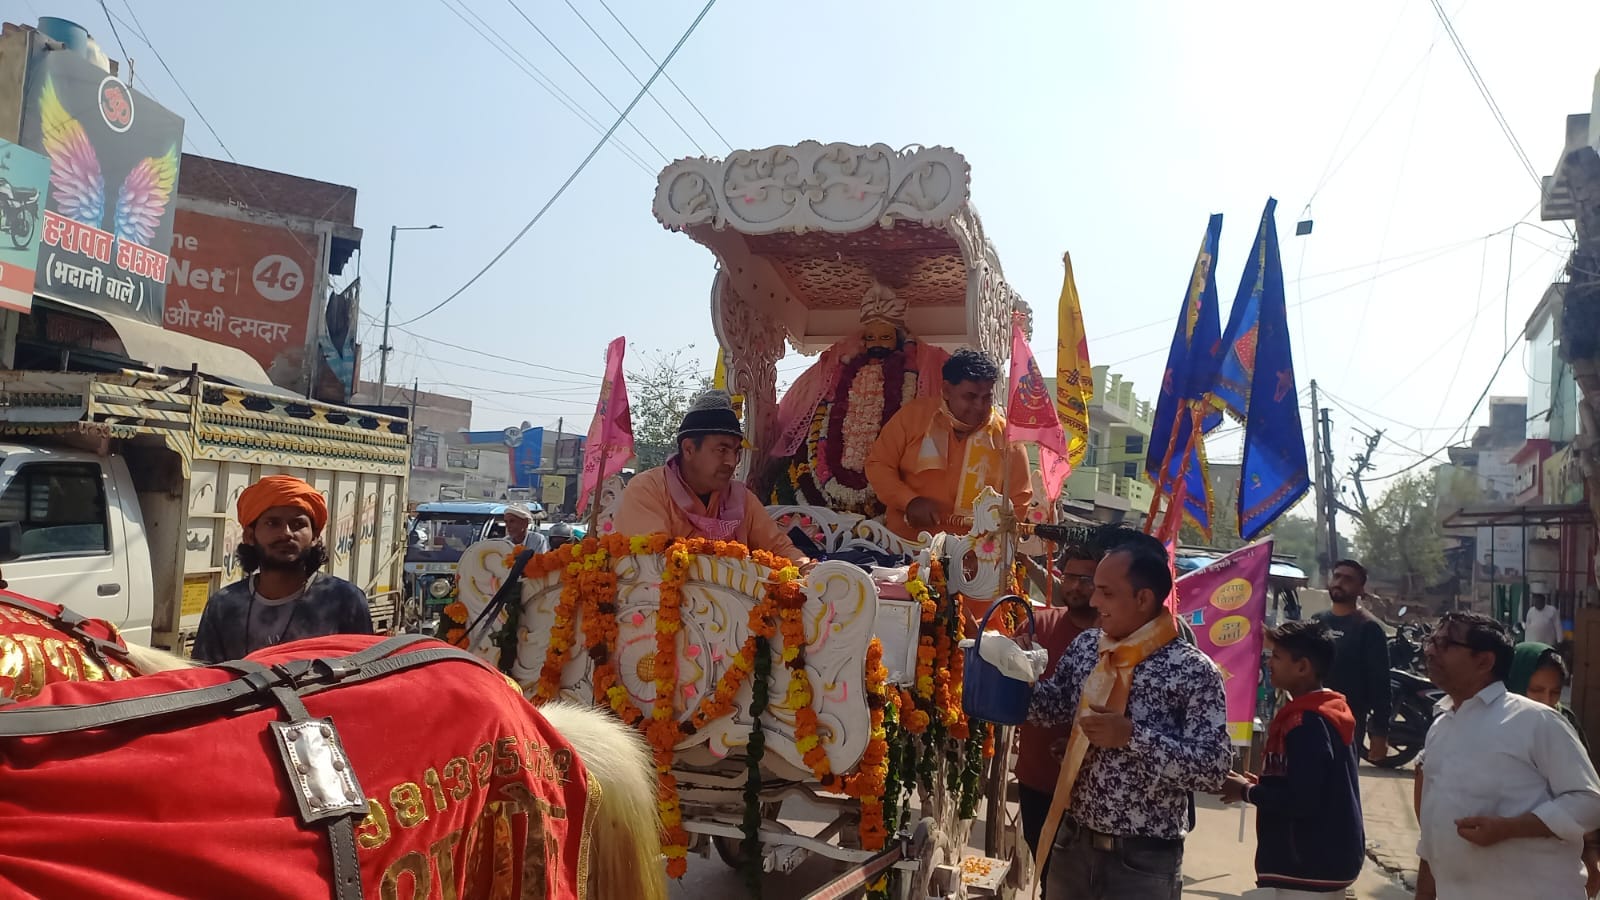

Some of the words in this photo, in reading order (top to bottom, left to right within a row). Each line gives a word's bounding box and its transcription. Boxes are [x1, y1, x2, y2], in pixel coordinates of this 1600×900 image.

[40, 209, 115, 265] हरावत
[117, 237, 169, 284] हाऊस
[256, 260, 299, 292] 4G
[165, 299, 202, 329] और
[203, 306, 226, 333] भी
[228, 316, 292, 344] दमदार
